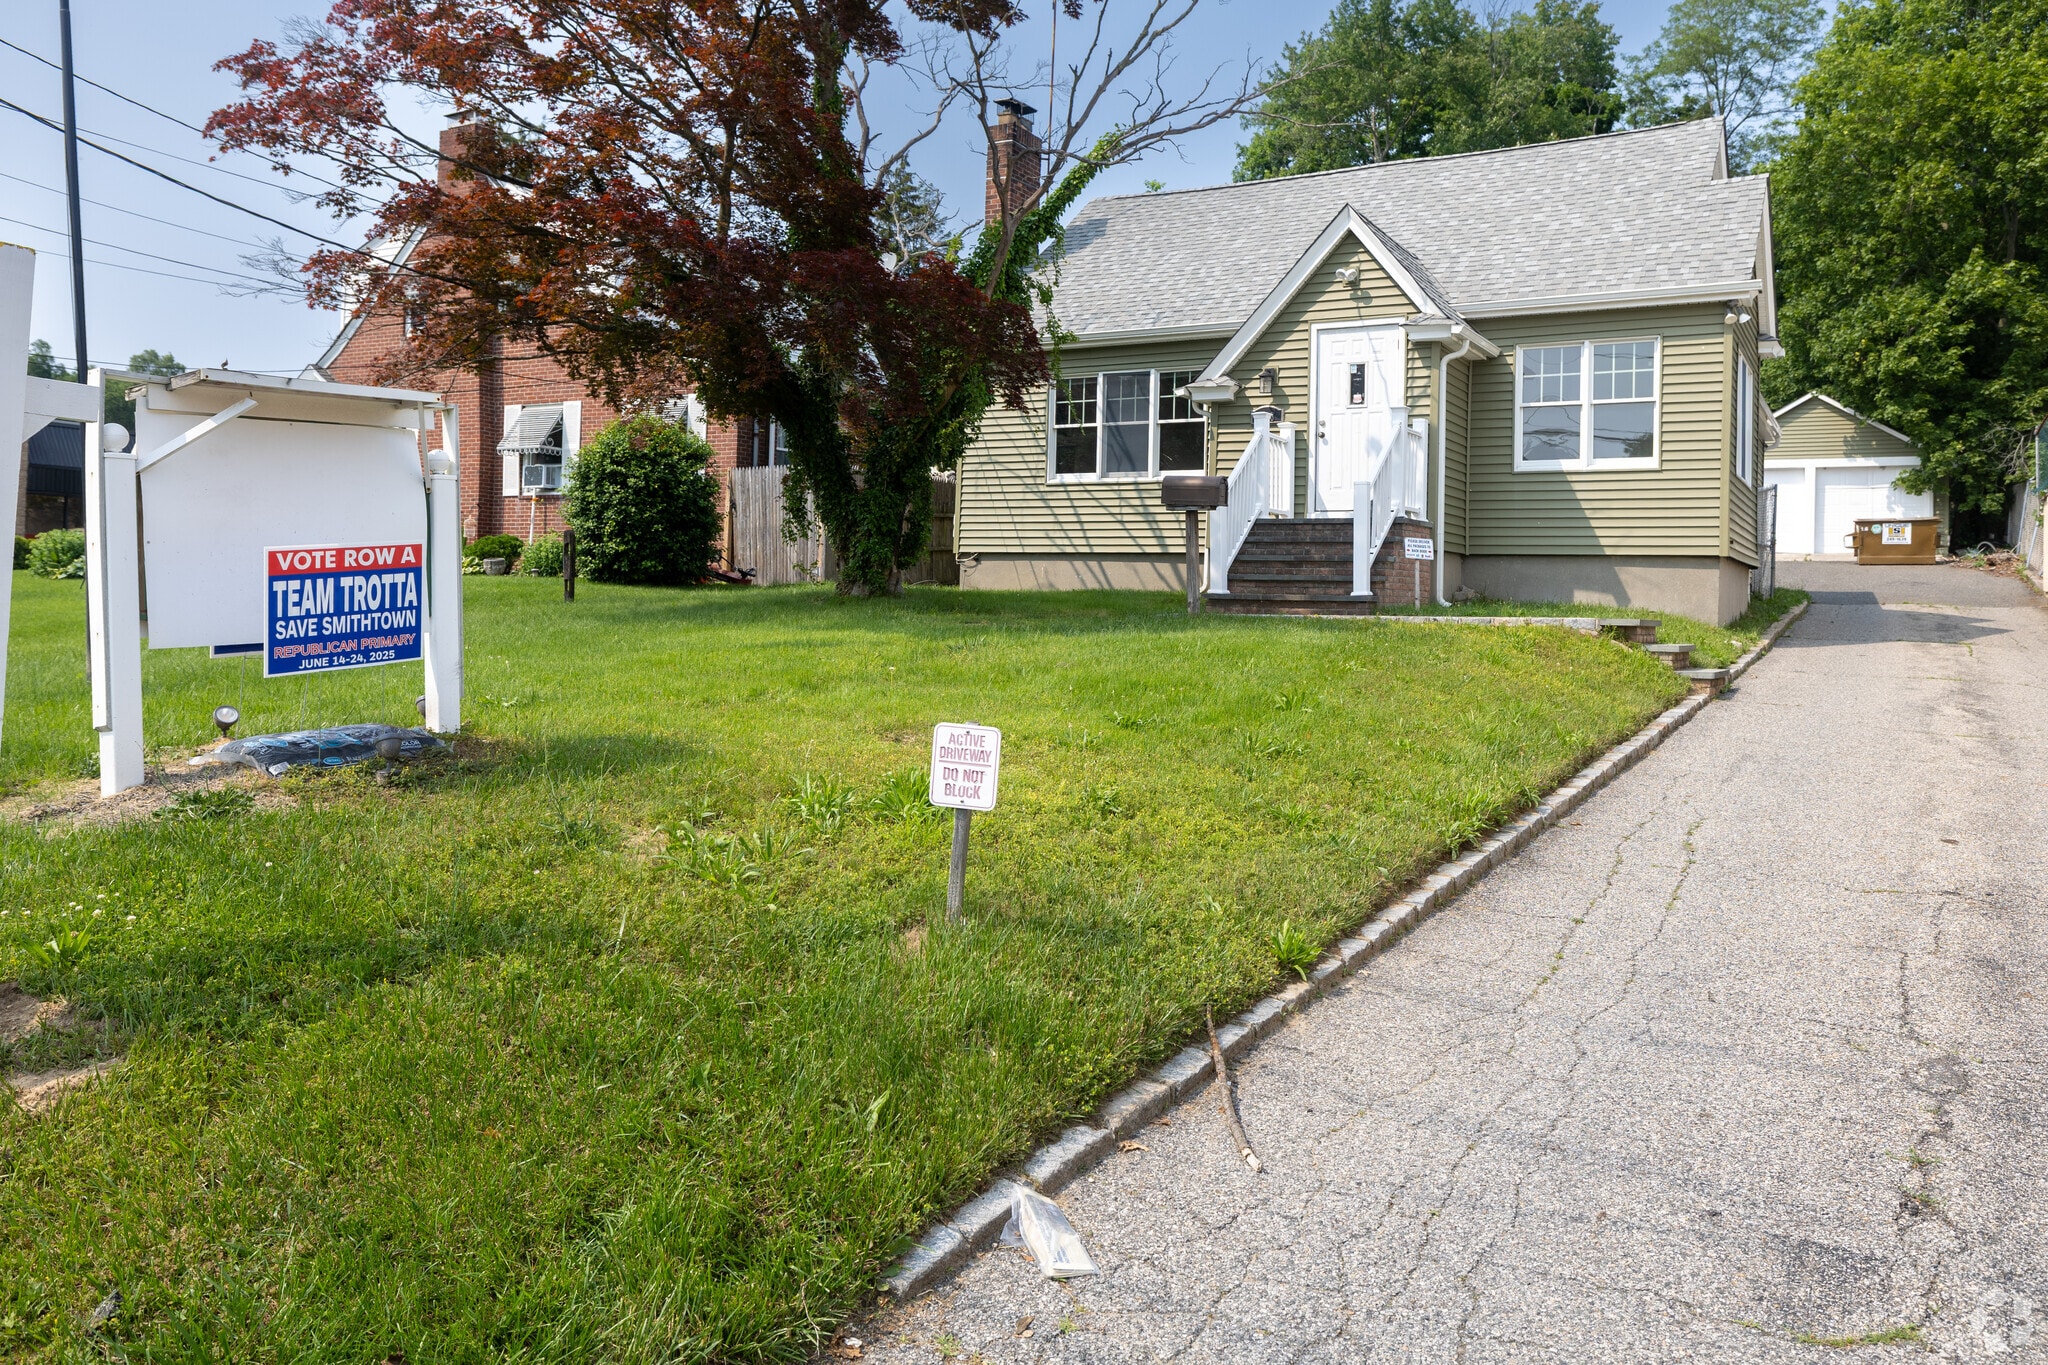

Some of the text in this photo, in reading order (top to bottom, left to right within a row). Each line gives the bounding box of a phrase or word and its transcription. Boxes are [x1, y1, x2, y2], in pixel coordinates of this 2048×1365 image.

[275, 546, 416, 571] VOTE ROW A
[272, 572, 418, 618] TEAM TROTTA
[275, 609, 416, 640] SAVE SMITHTOWN
[273, 633, 416, 659] REPUBLICAN PRIMARY
[298, 650, 395, 670] JUNE 14-24, 2025
[948, 732, 986, 748] ACTIVE
[939, 746, 992, 763] DRIVEWAY
[942, 766, 985, 784] DO NOT
[944, 782, 981, 800] BLOCK
